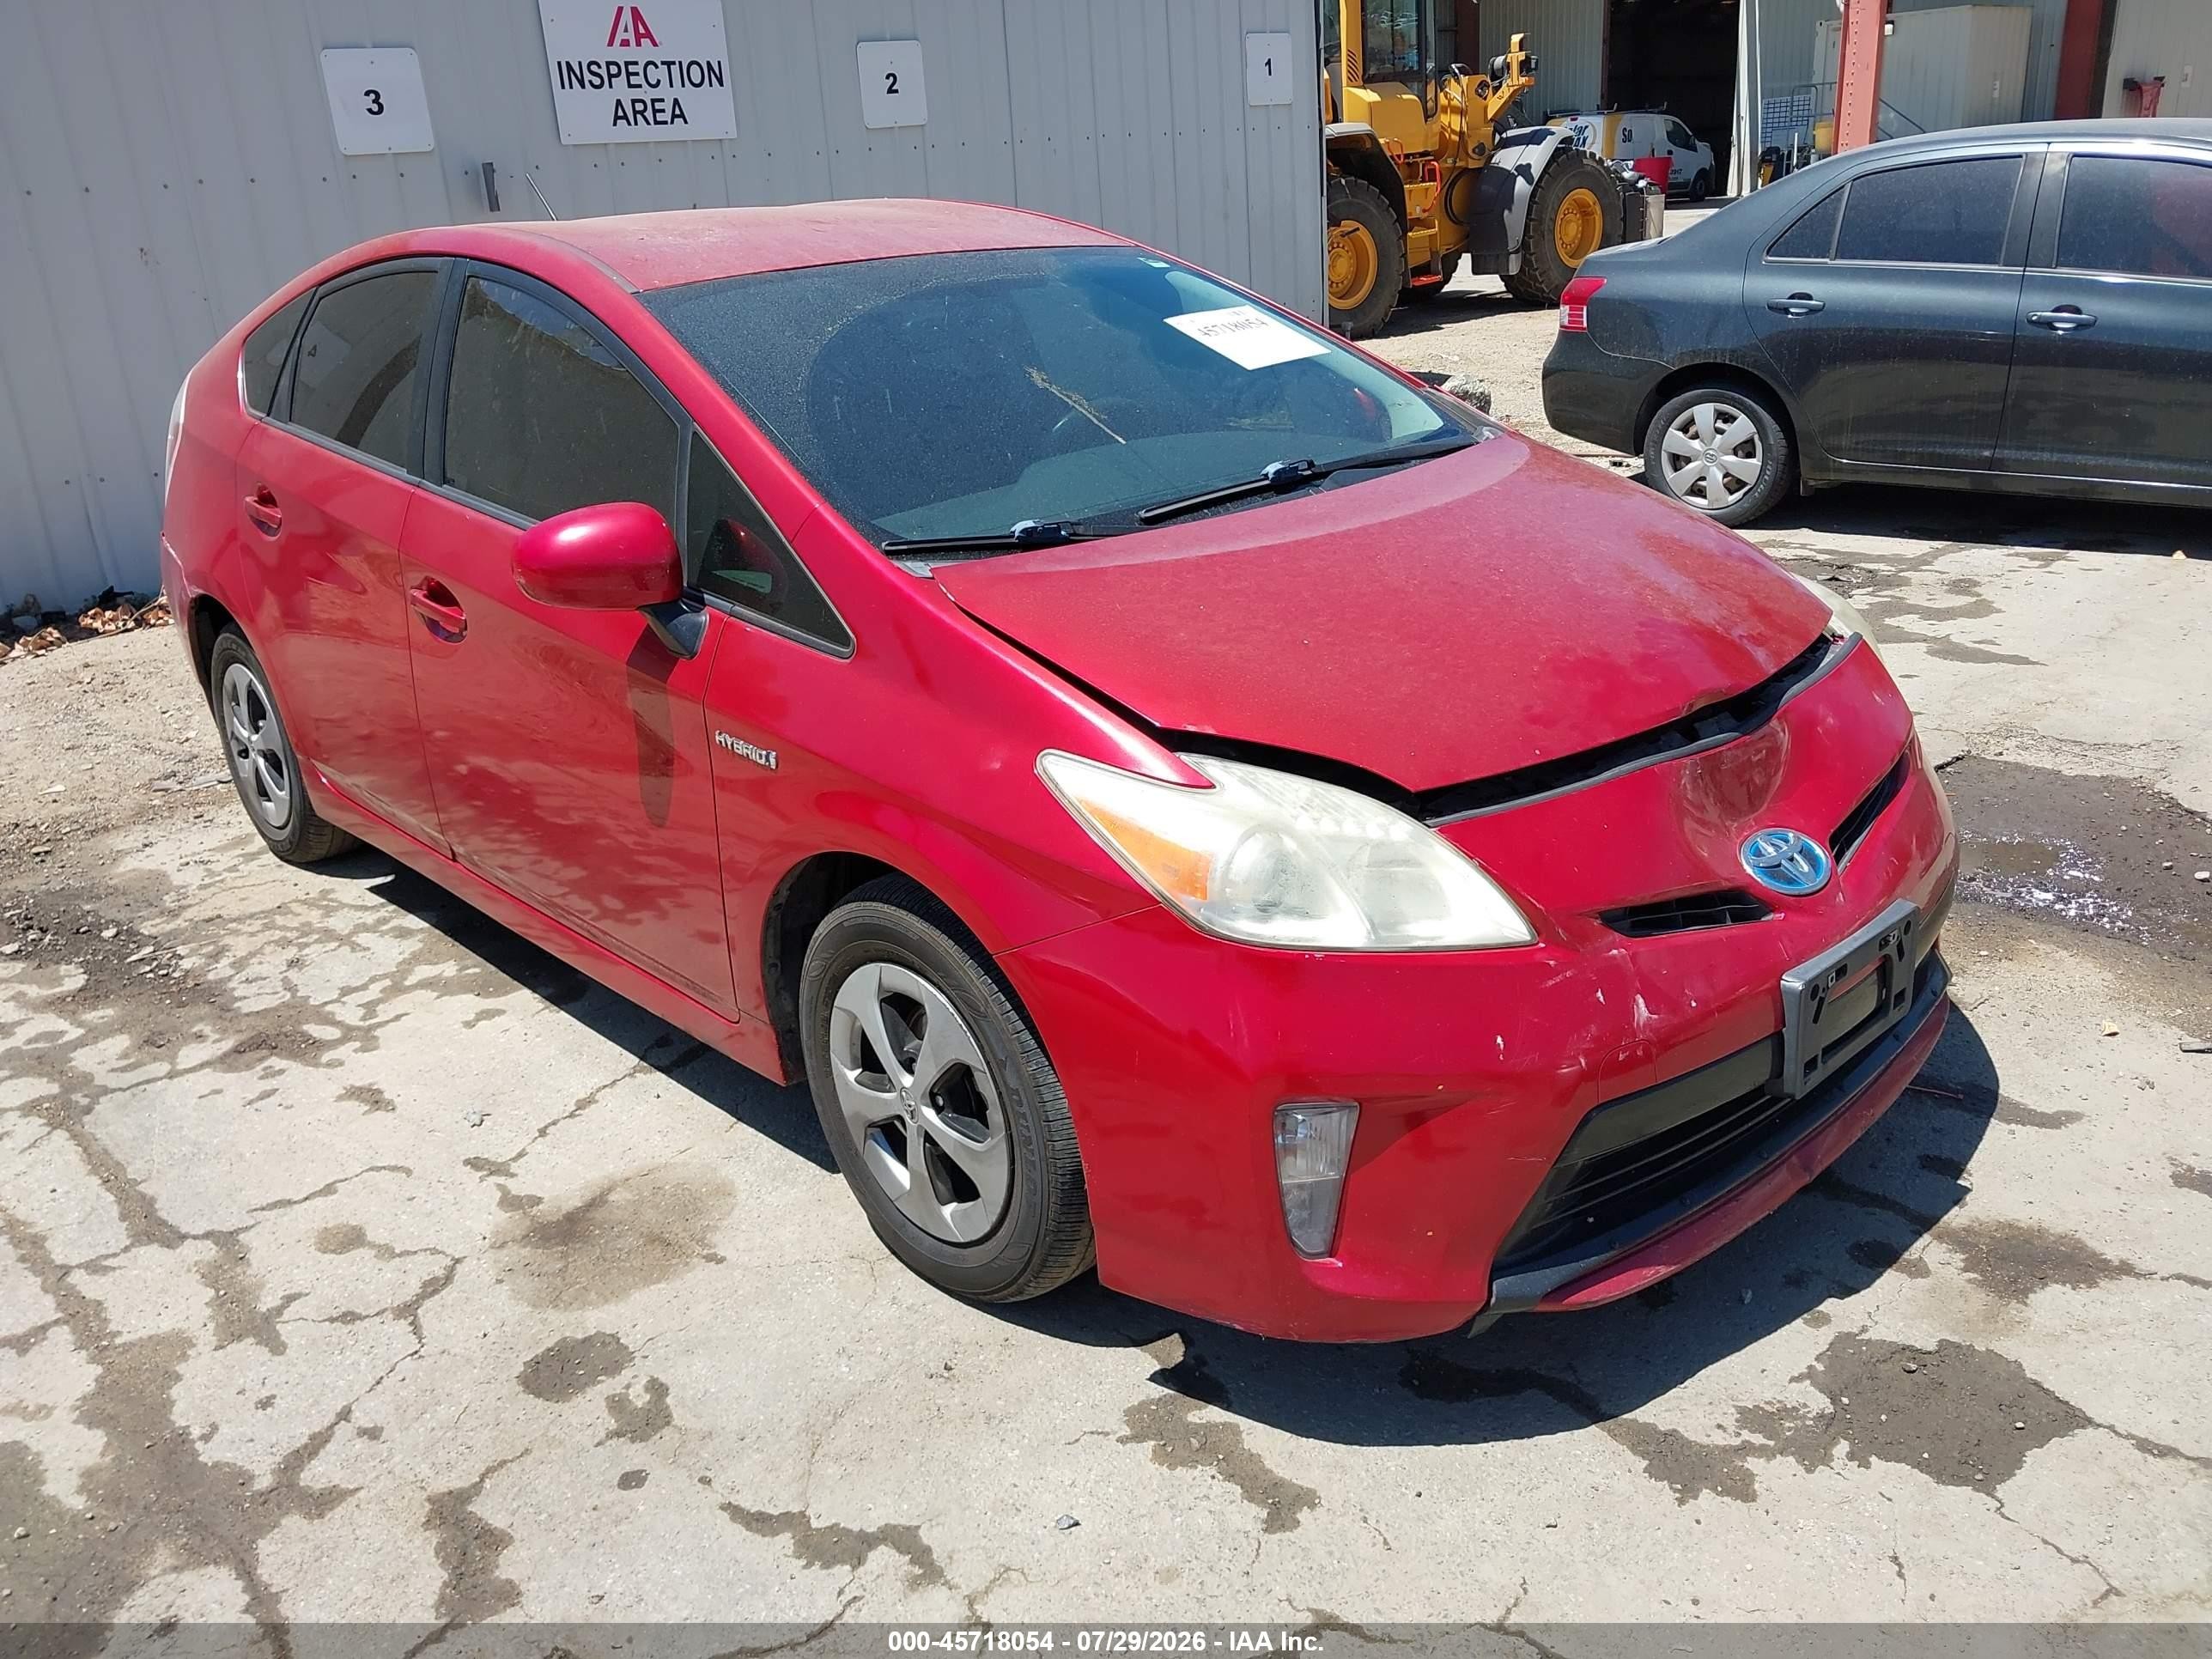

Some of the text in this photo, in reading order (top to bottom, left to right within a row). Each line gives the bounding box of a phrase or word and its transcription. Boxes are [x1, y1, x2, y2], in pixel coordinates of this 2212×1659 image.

[556, 60, 725, 90] INSPECTION
[1264, 58, 1272, 76] 1
[884, 72, 899, 94] 2
[363, 88, 385, 116] 3
[612, 97, 689, 127] AREA
[715, 730, 766, 765] HYBRID
